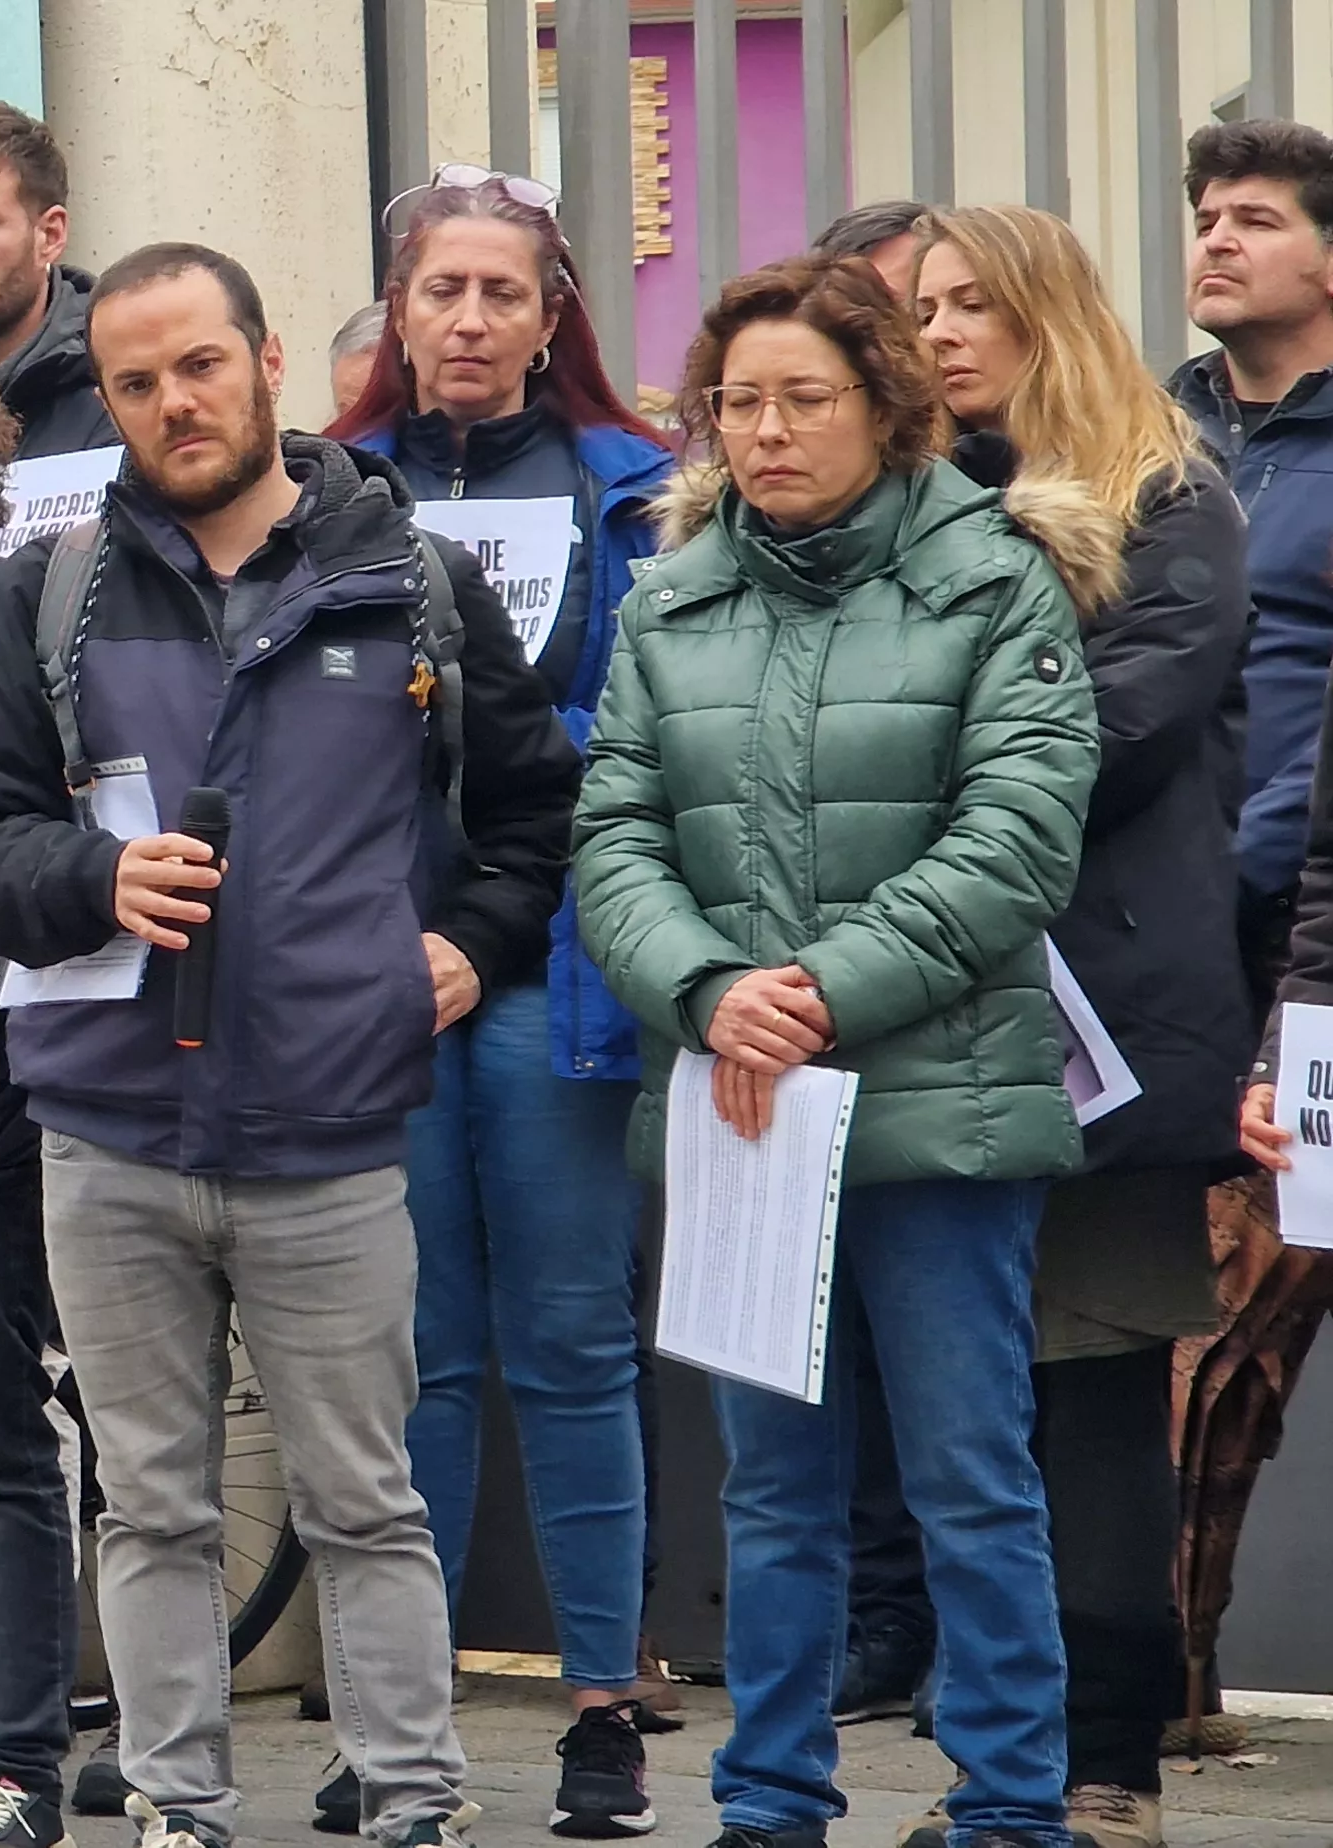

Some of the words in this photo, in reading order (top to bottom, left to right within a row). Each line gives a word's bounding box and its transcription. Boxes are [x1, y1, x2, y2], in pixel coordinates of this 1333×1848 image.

[24, 489, 104, 522] VOCACI
[477, 538, 506, 572] DE
[492, 577, 553, 611] AMOS
[1307, 1059, 1333, 1102] QU
[1300, 1107, 1332, 1147] NO
